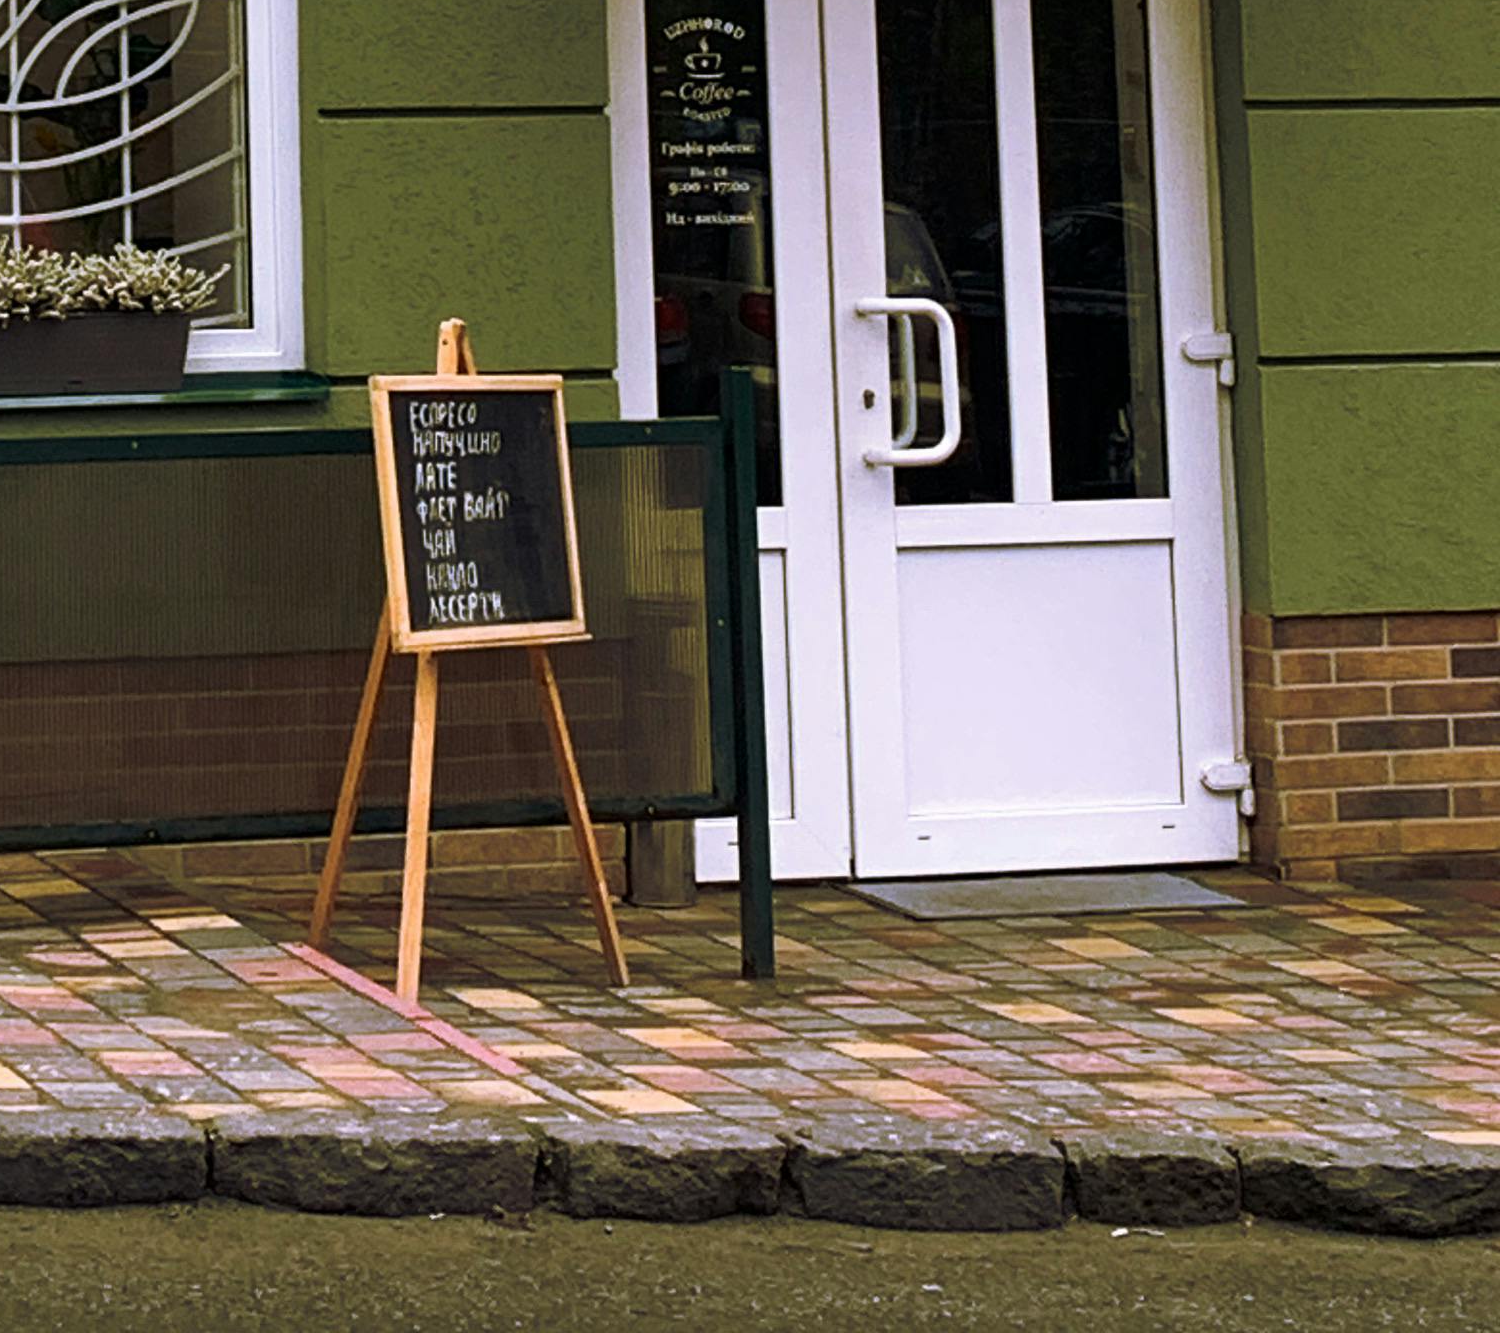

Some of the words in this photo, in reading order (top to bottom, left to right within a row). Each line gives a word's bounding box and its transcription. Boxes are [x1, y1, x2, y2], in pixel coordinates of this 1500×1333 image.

[664, 18, 746, 41] UZHHOROD
[679, 82, 735, 105] Coffee
[409, 401, 477, 433] ЕСПРЕСО
[415, 461, 457, 495] ЛАТЕ
[416, 496, 457, 525] ФЛЕТ
[422, 520, 456, 559] ЧАЙ
